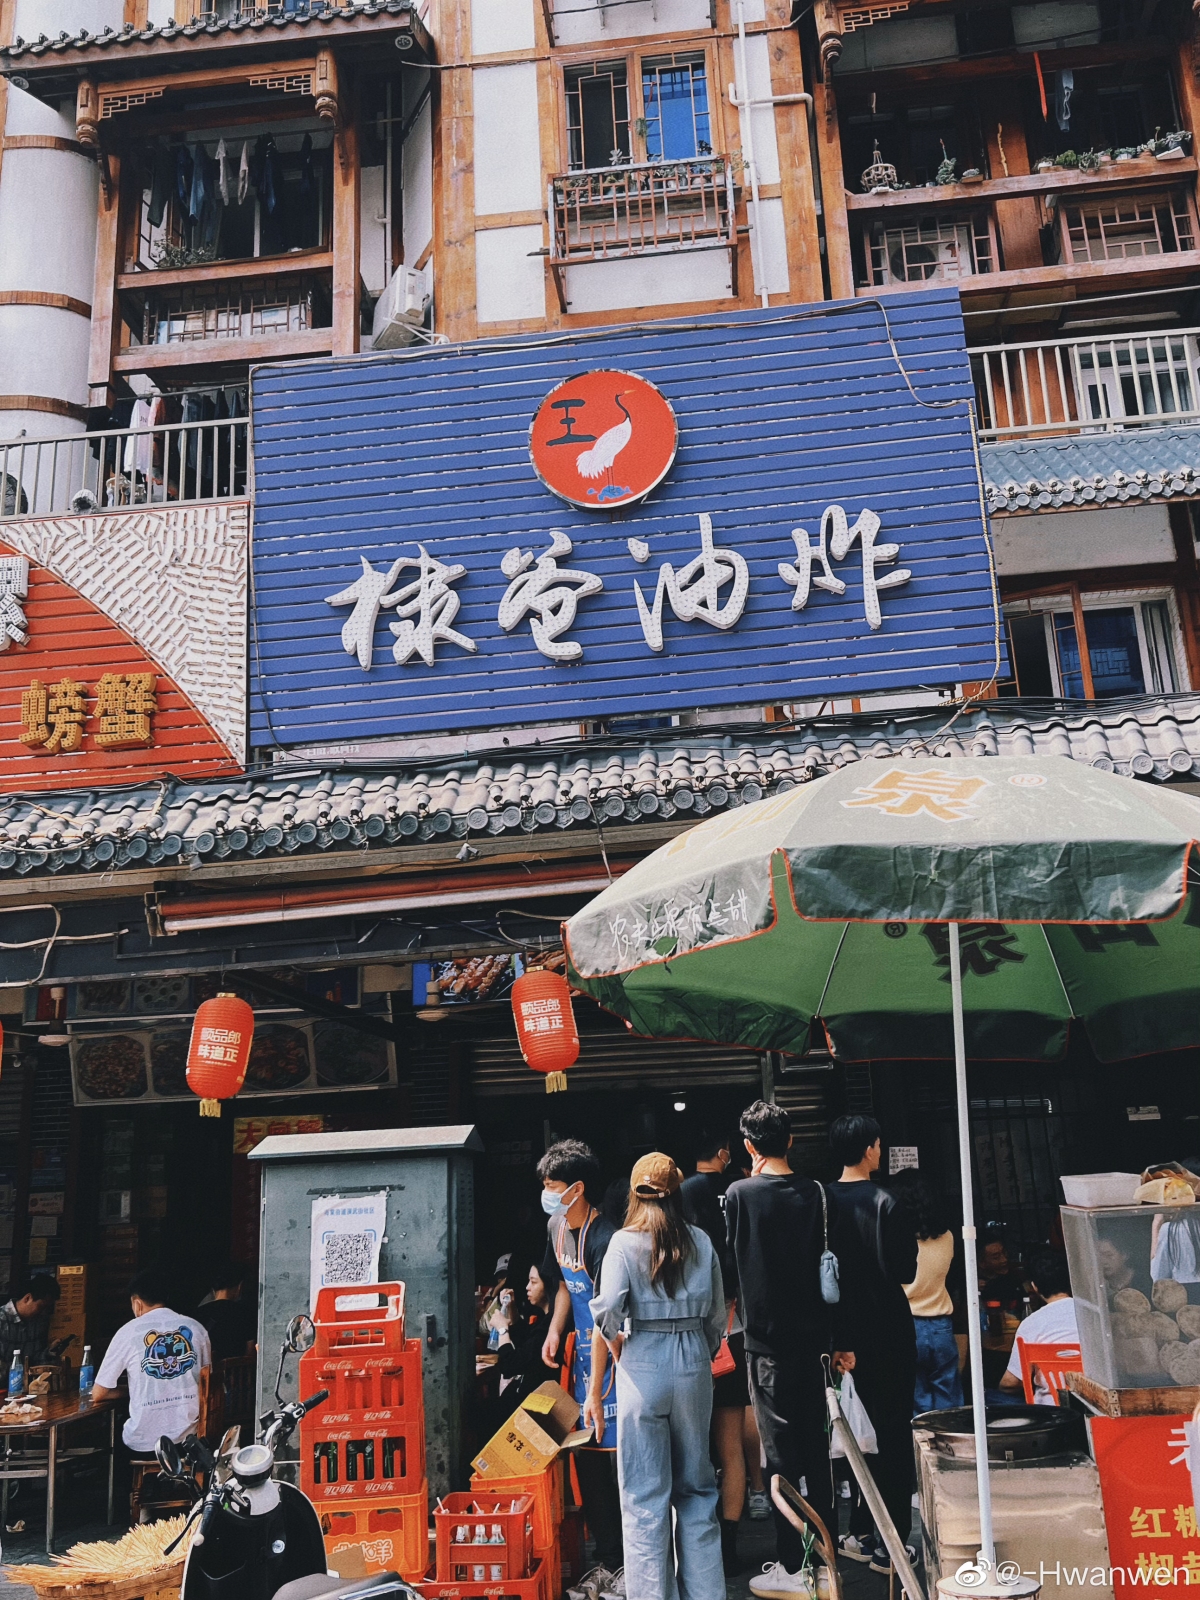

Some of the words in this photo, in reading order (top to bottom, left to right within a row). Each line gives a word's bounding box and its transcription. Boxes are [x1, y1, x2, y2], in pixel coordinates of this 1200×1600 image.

[545, 398, 598, 446] 王
[18, 672, 158, 754] 螃蟹
[839, 766, 995, 824] 泉
[523, 1015, 564, 1032] 味道正
[197, 1045, 239, 1063] 味道正
[324, 1484, 355, 1496] 可口可乐
[365, 1482, 395, 1493] 可口可乐
